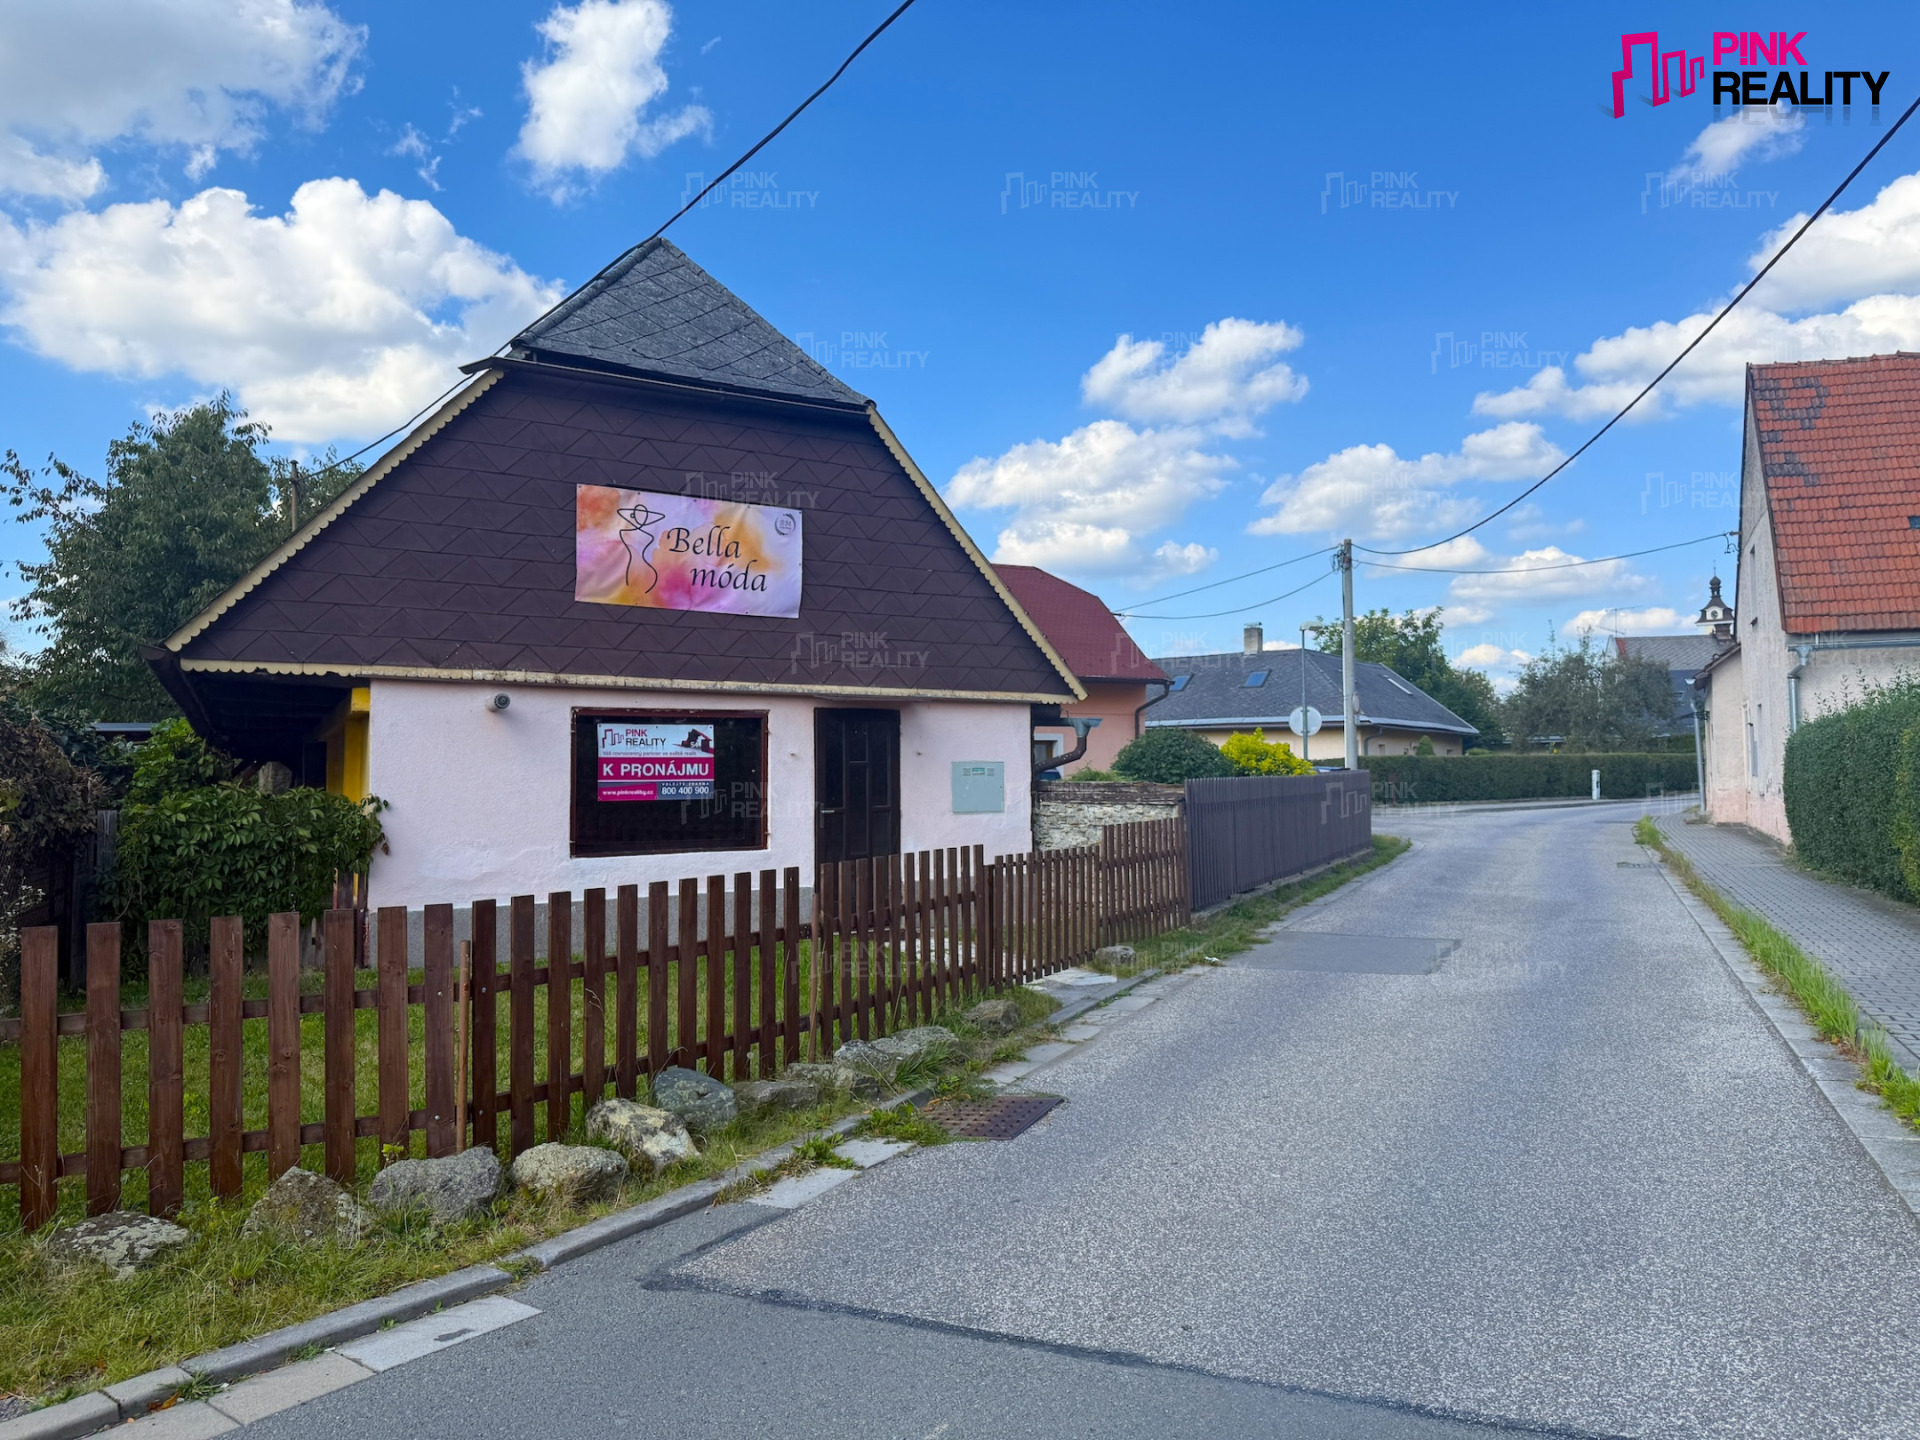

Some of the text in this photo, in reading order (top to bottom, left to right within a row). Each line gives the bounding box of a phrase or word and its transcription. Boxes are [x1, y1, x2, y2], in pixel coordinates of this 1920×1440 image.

[667, 525, 741, 559] Bella
[690, 559, 767, 592] móda
[625, 737, 667, 746] REALITY
[602, 760, 709, 777] K PRONÁJMU
[661, 786, 710, 795] 800 400 900
